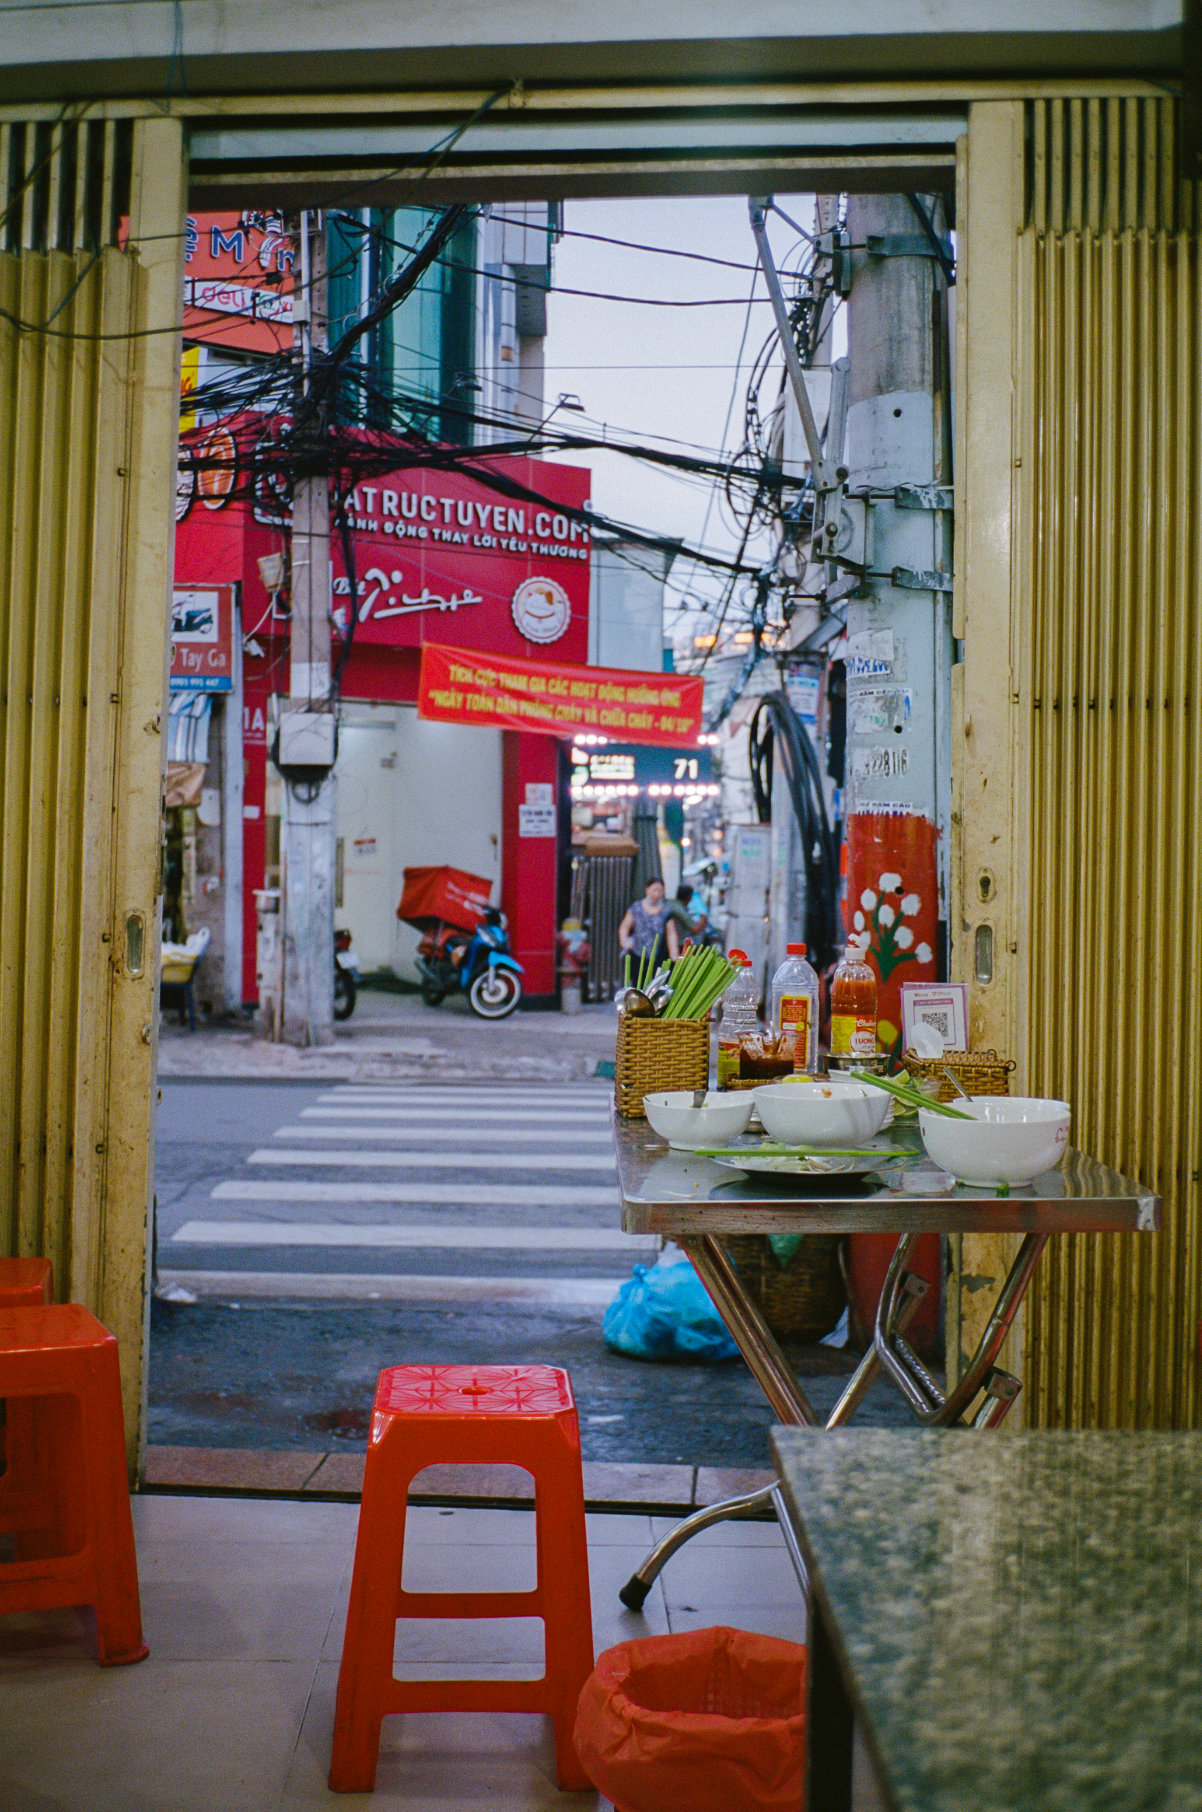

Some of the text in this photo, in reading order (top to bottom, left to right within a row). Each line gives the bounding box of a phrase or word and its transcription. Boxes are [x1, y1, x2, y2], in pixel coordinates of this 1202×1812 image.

[334, 486, 589, 543] ATRUCTUYEN.COM
[432, 528, 469, 544] THAY
[181, 648, 204, 673] Tay
[207, 648, 227, 668] Ga
[673, 758, 698, 781] 71
